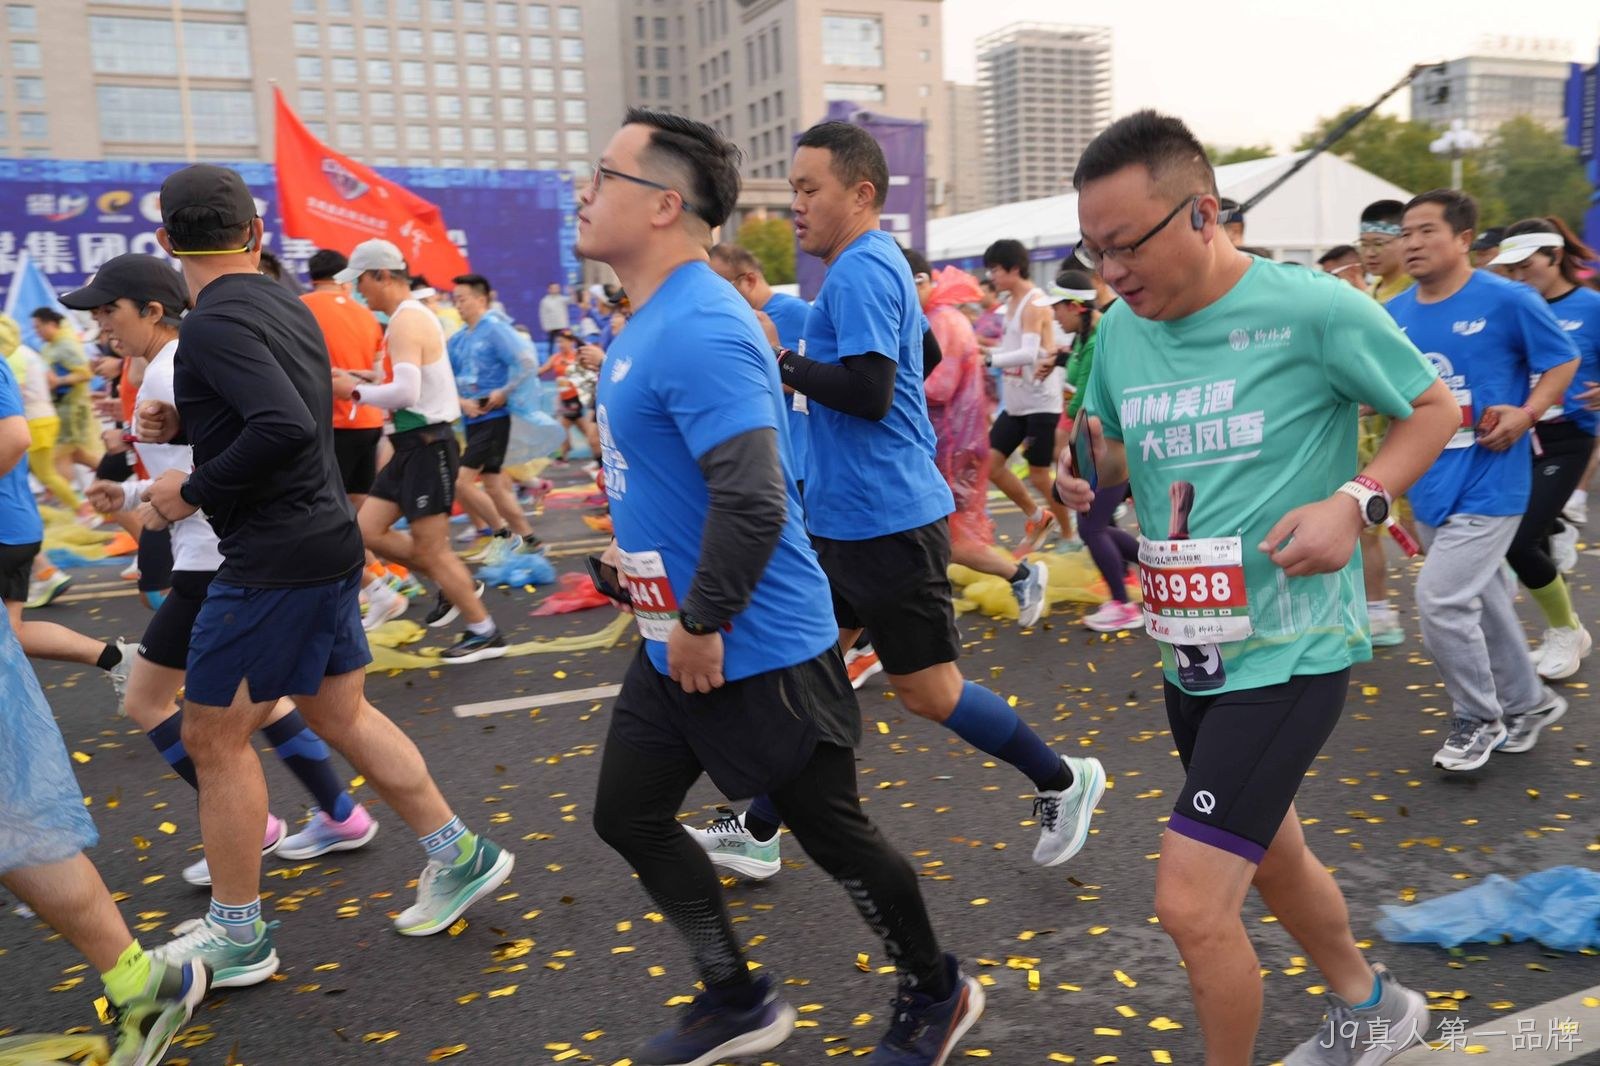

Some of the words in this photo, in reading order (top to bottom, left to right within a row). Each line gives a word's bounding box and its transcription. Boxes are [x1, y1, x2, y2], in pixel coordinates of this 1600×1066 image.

[1120, 379, 1236, 430] 柳林美酒
[1140, 410, 1265, 462] 大器凤香
[1141, 568, 1231, 602] C13938
